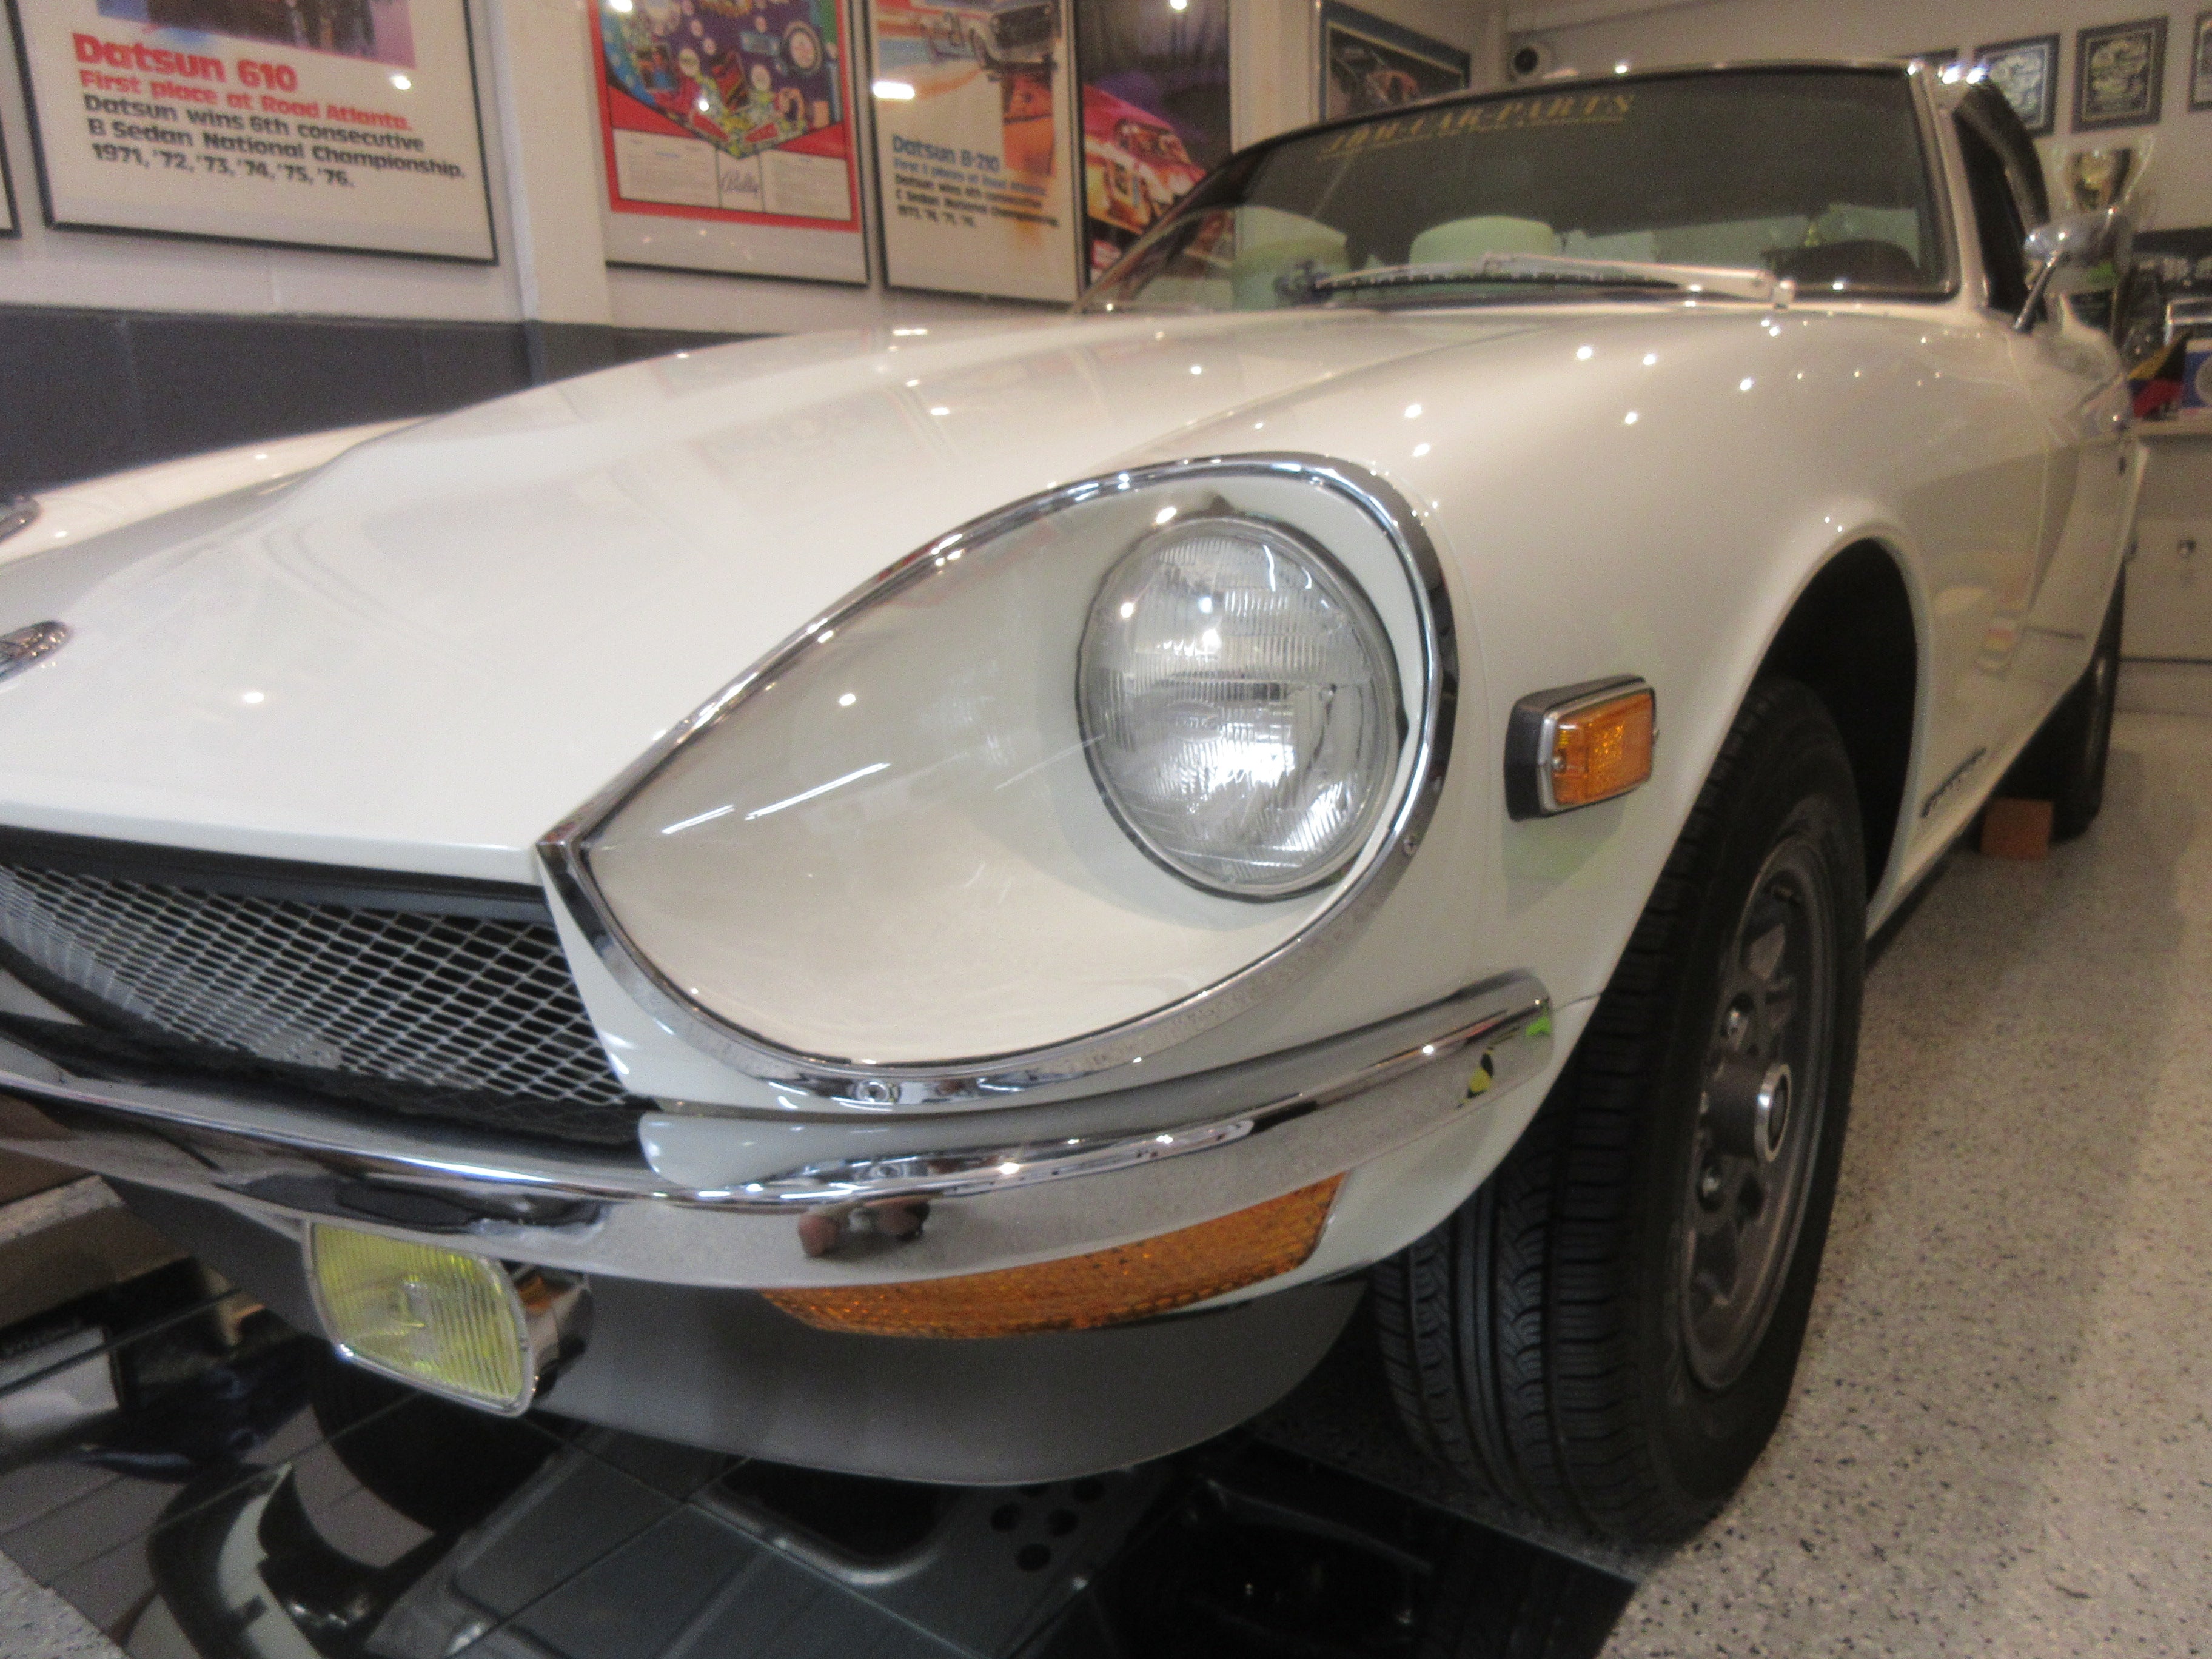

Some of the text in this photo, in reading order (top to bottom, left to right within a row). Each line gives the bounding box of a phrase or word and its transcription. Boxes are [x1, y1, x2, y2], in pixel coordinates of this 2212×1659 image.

[72, 33, 298, 92] Datsun 610
[79, 69, 413, 131] First place at Road Atlanta.
[84, 93, 423, 149] Datsun wins 6th consecutive
[87, 118, 466, 179] B Sedan National Championship.
[92, 143, 150, 169] 1971,
[153, 149, 195, 173] '72,
[196, 155, 235, 177] '73,
[893, 134, 956, 164] Datsun
[960, 149, 1000, 173] B-210
